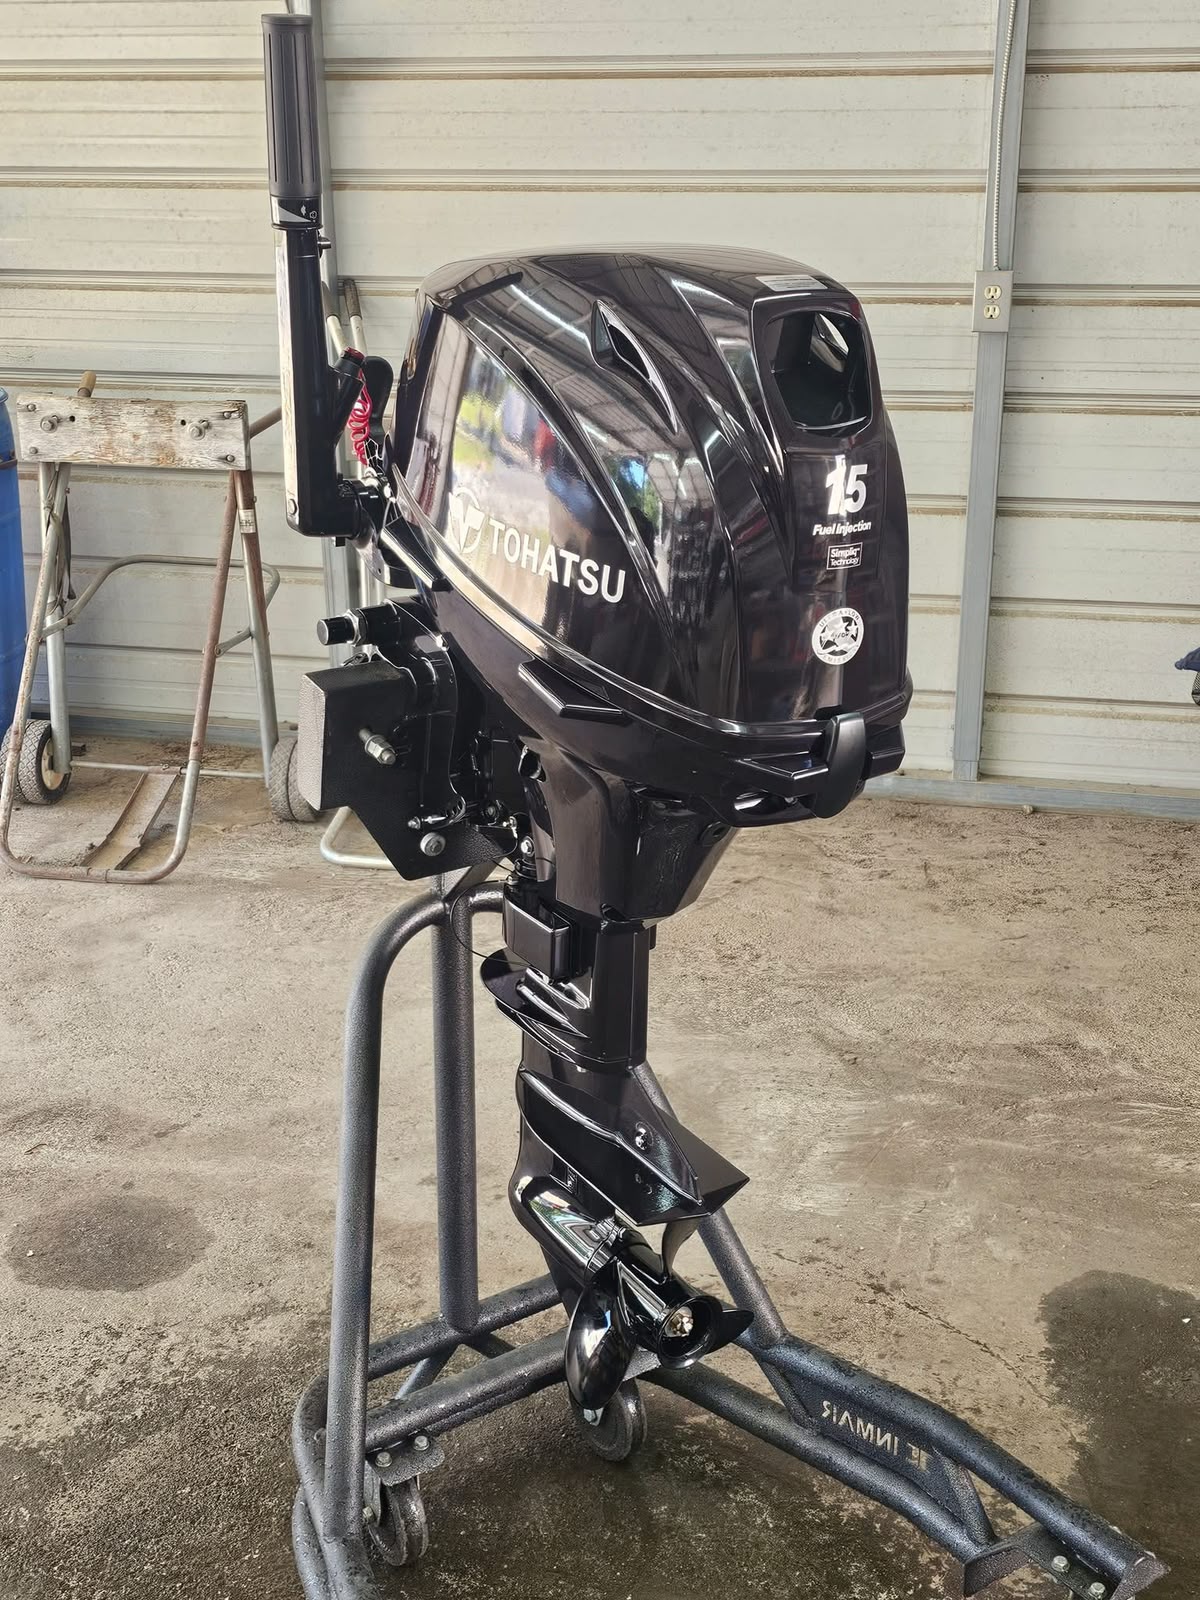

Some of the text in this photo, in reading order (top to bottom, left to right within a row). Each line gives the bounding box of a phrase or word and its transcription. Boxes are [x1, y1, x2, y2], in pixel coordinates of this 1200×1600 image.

[825, 463, 868, 515] 15
[812, 520, 872, 537] Fuel Injection
[488, 518, 626, 604] TOHATSU
